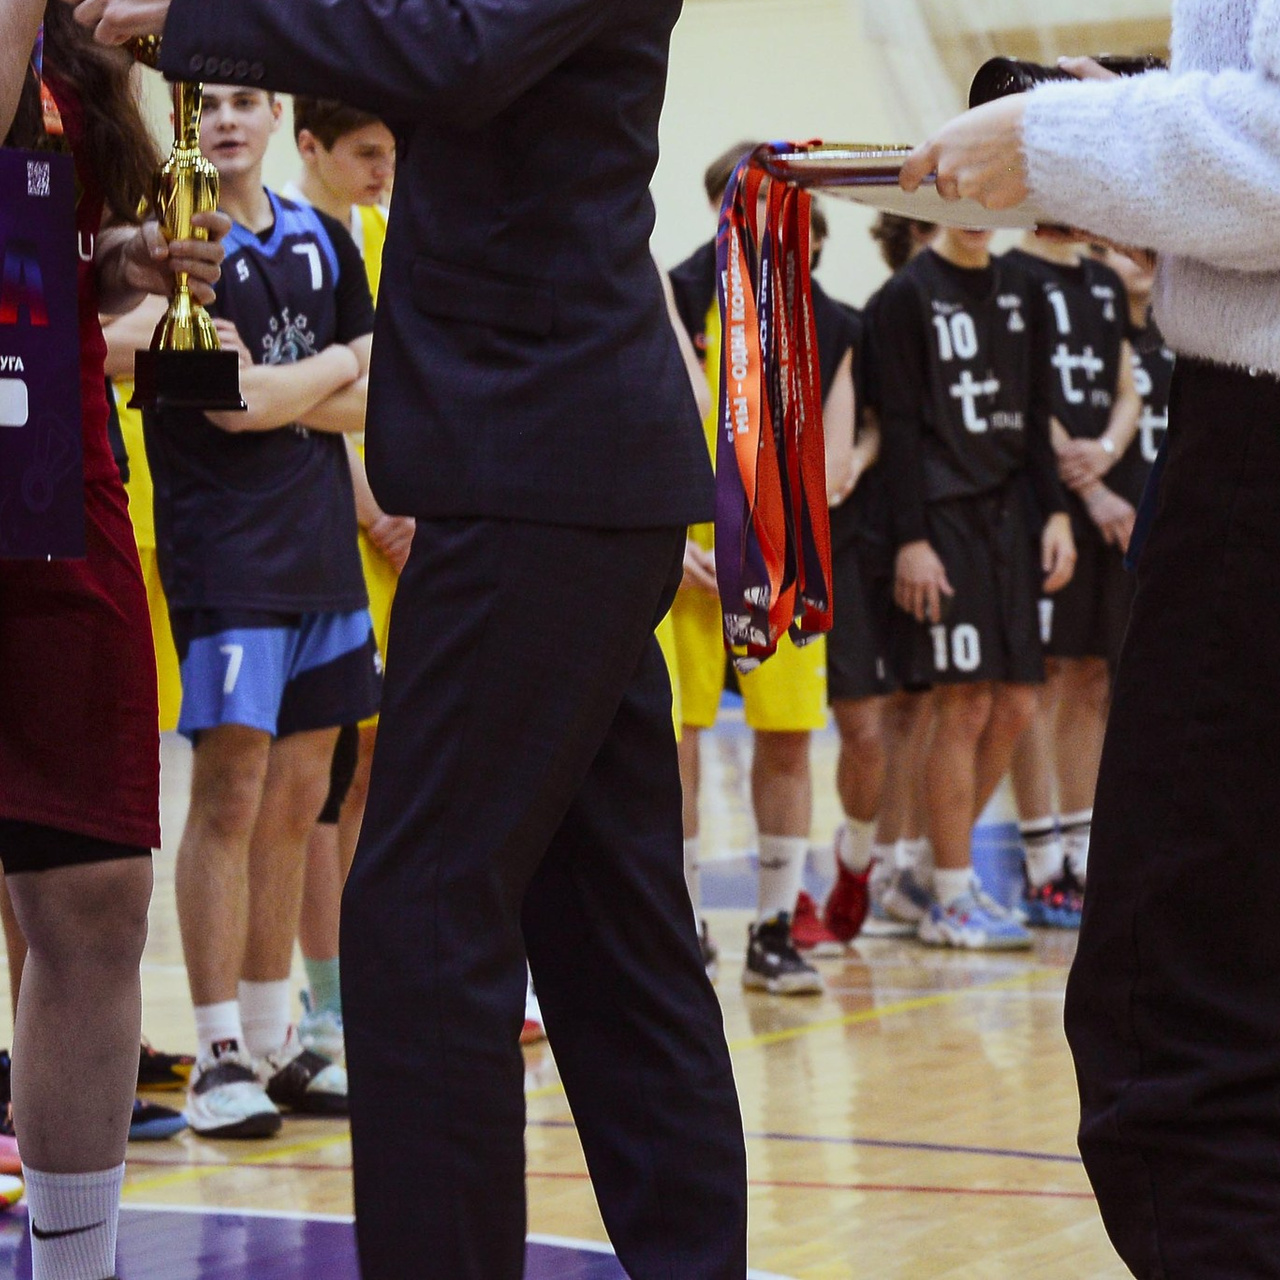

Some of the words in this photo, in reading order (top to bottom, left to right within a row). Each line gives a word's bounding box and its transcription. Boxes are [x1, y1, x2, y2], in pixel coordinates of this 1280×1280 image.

[292, 242, 323, 291] 7
[933, 311, 979, 362] 10
[1047, 289, 1071, 336] 1
[731, 324, 748, 381] ОДНА
[220, 644, 244, 694] 7
[931, 624, 981, 672] 10
